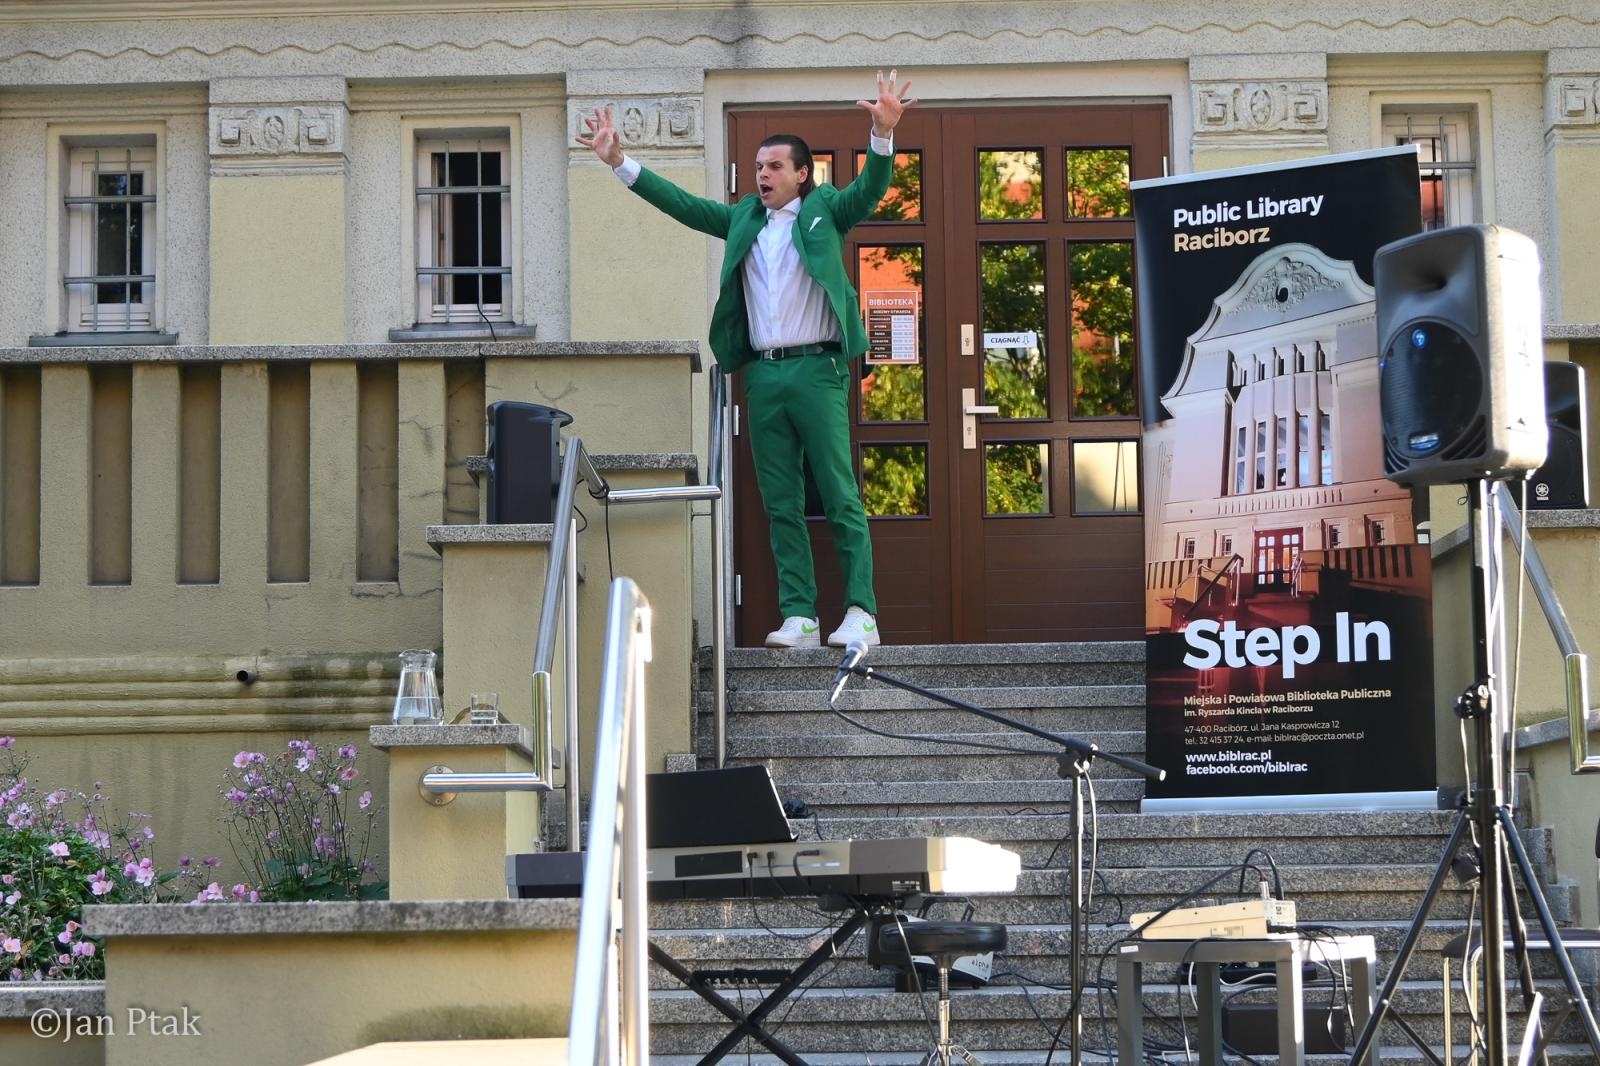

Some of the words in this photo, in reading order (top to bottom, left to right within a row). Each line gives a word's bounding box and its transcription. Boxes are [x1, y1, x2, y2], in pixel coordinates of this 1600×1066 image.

[1174, 201, 1241, 228] Public
[1246, 194, 1324, 219] Library
[1174, 227, 1270, 252] Raciborz
[868, 298, 914, 306] BIBLIOTEKA
[1183, 618, 1321, 679] Step
[1336, 611, 1391, 662] In
[1184, 695, 1222, 707] Miejska
[1223, 694, 1227, 704] i
[1228, 693, 1285, 704] Powiatowa
[1287, 690, 1339, 702] Biblioteka
[1341, 688, 1392, 699] Publiczna
[1184, 708, 1197, 717] im.
[1198, 707, 1235, 718] Ryszarda
[1236, 706, 1263, 715] Kincla
[1272, 704, 1314, 714] Raciborzu
[1184, 725, 1212, 734] 47-400
[1260, 722, 1280, 731] Jana
[1280, 721, 1330, 731] Kasprowicza
[1331, 720, 1340, 729] 12
[1199, 736, 1208, 745] 32
[1209, 735, 1222, 744] 415
[1223, 735, 1233, 744] 37
[1274, 731, 1364, 743] biblrac@poczta.onet.pl
[1185, 749, 1272, 763] www.biblrac.pl
[1186, 761, 1308, 775] facebook.com/biblrac
